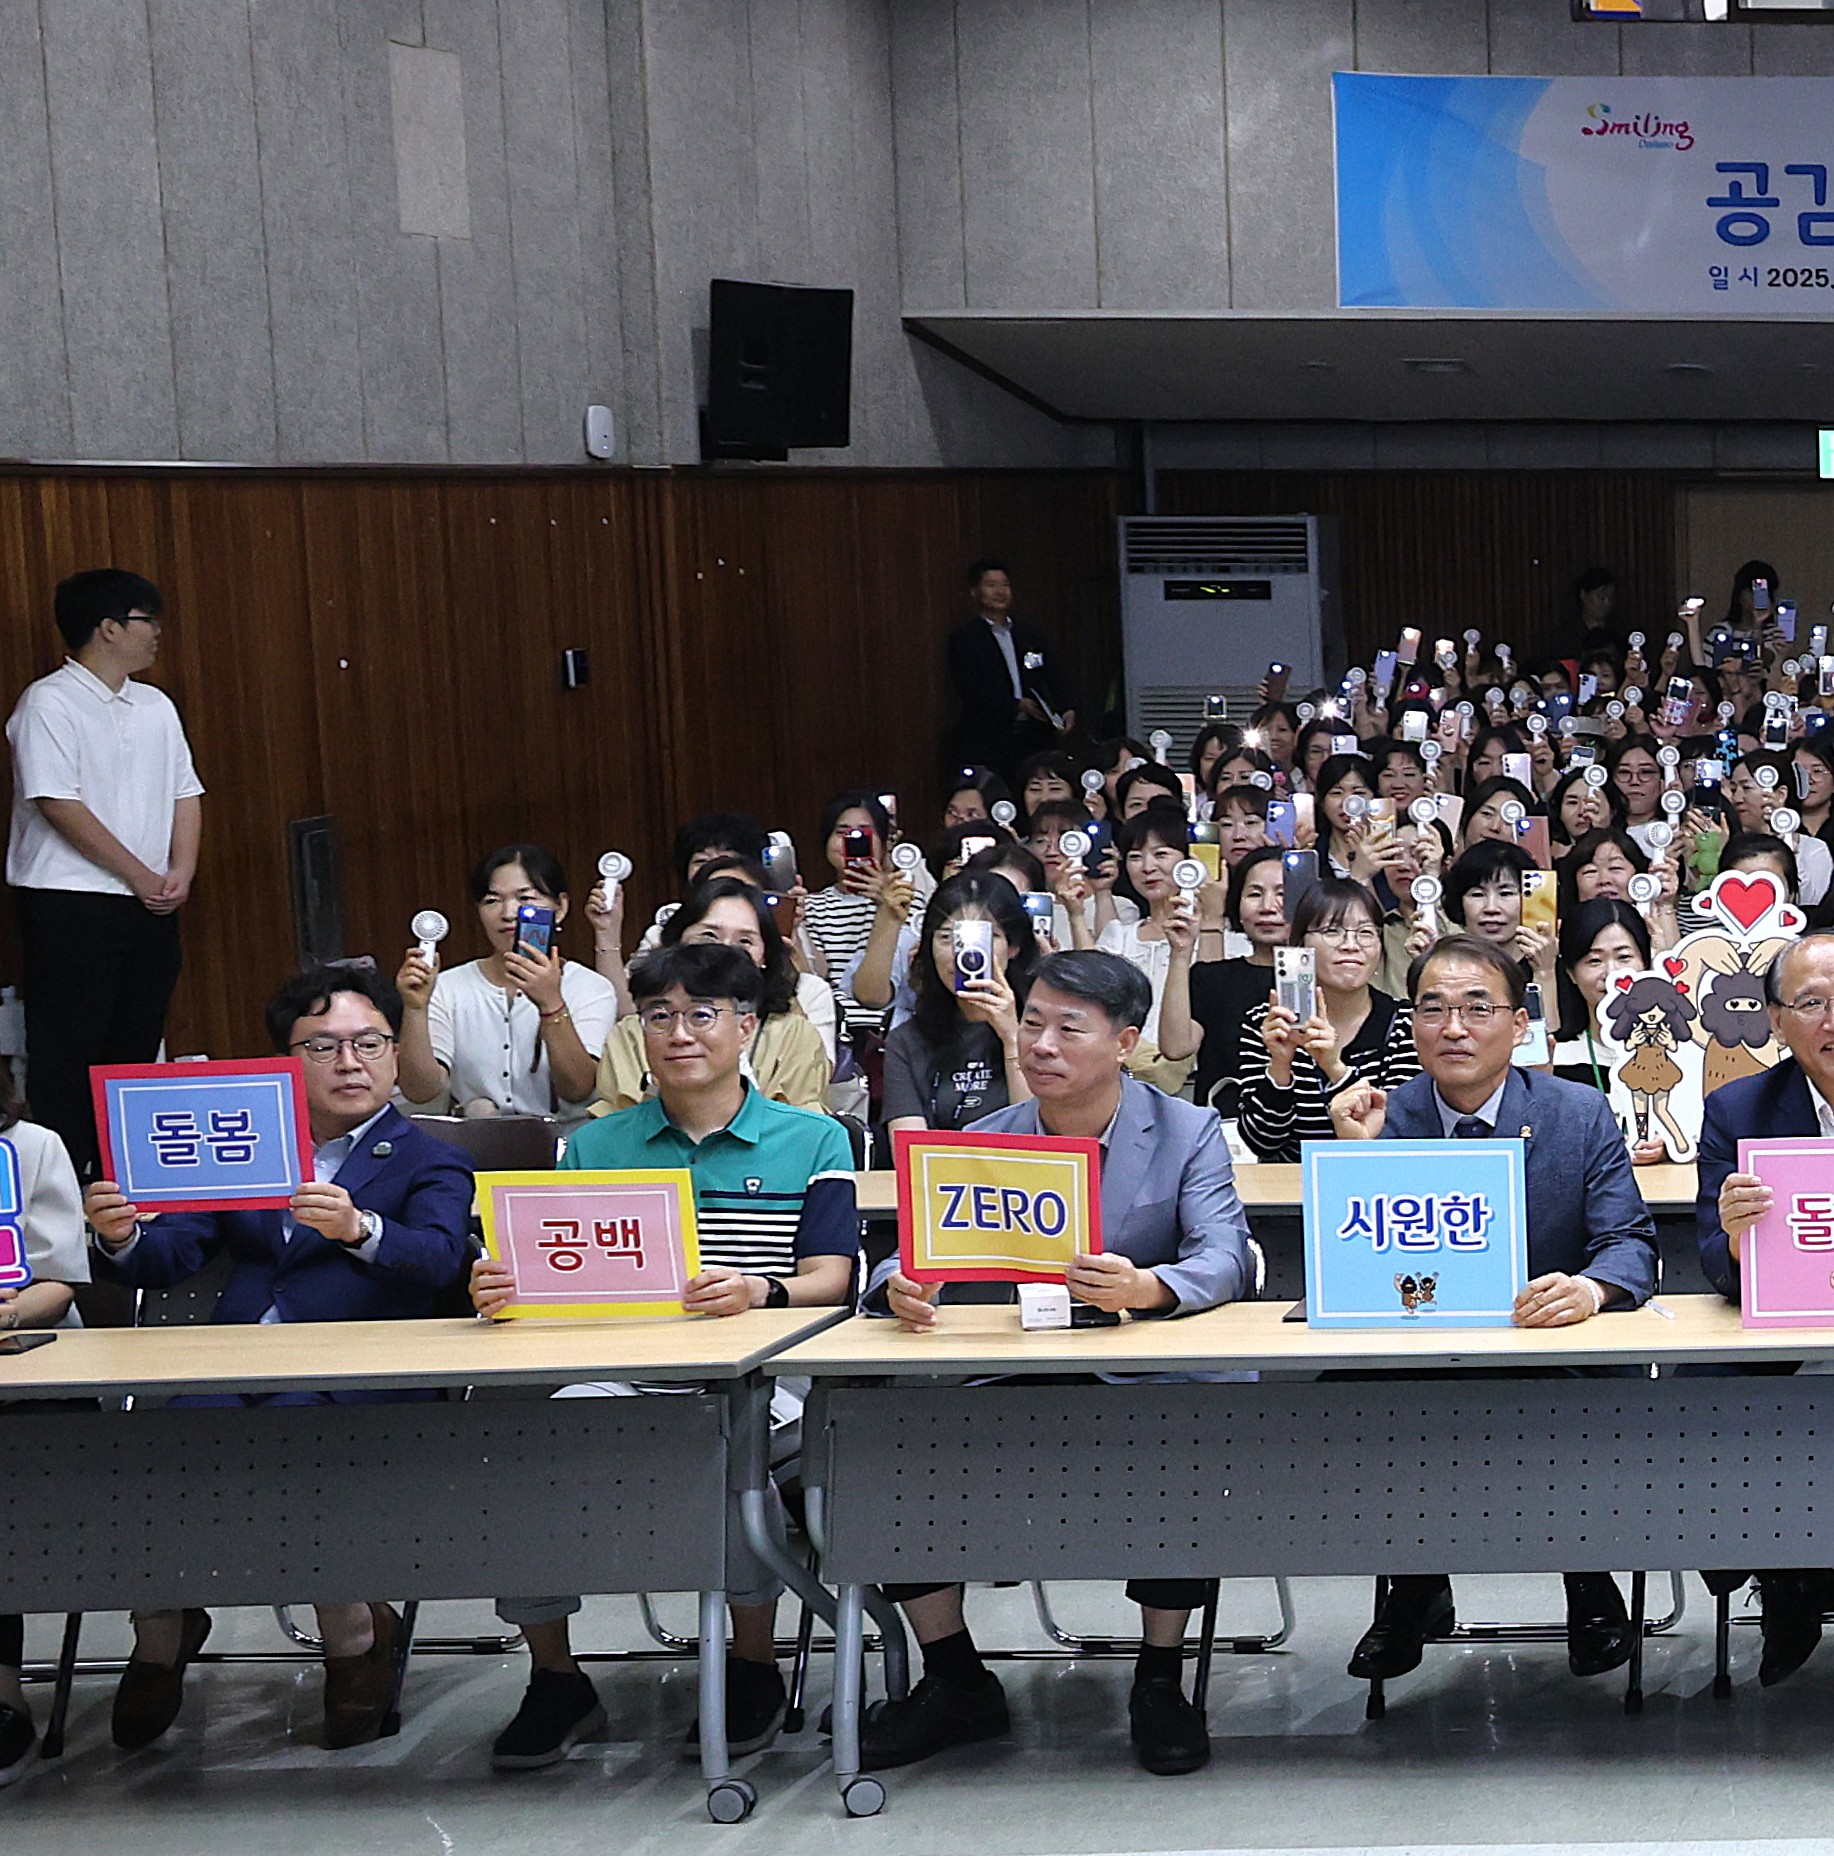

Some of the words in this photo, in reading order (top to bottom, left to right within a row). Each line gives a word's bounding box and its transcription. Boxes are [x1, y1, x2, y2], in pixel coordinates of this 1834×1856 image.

[1582, 103, 1695, 151] Smiling
[149, 1108, 259, 1166] 돌봄
[938, 1183, 1066, 1236] ZERO
[1337, 1192, 1493, 1252] 시원한
[536, 1219, 645, 1273] 공백
